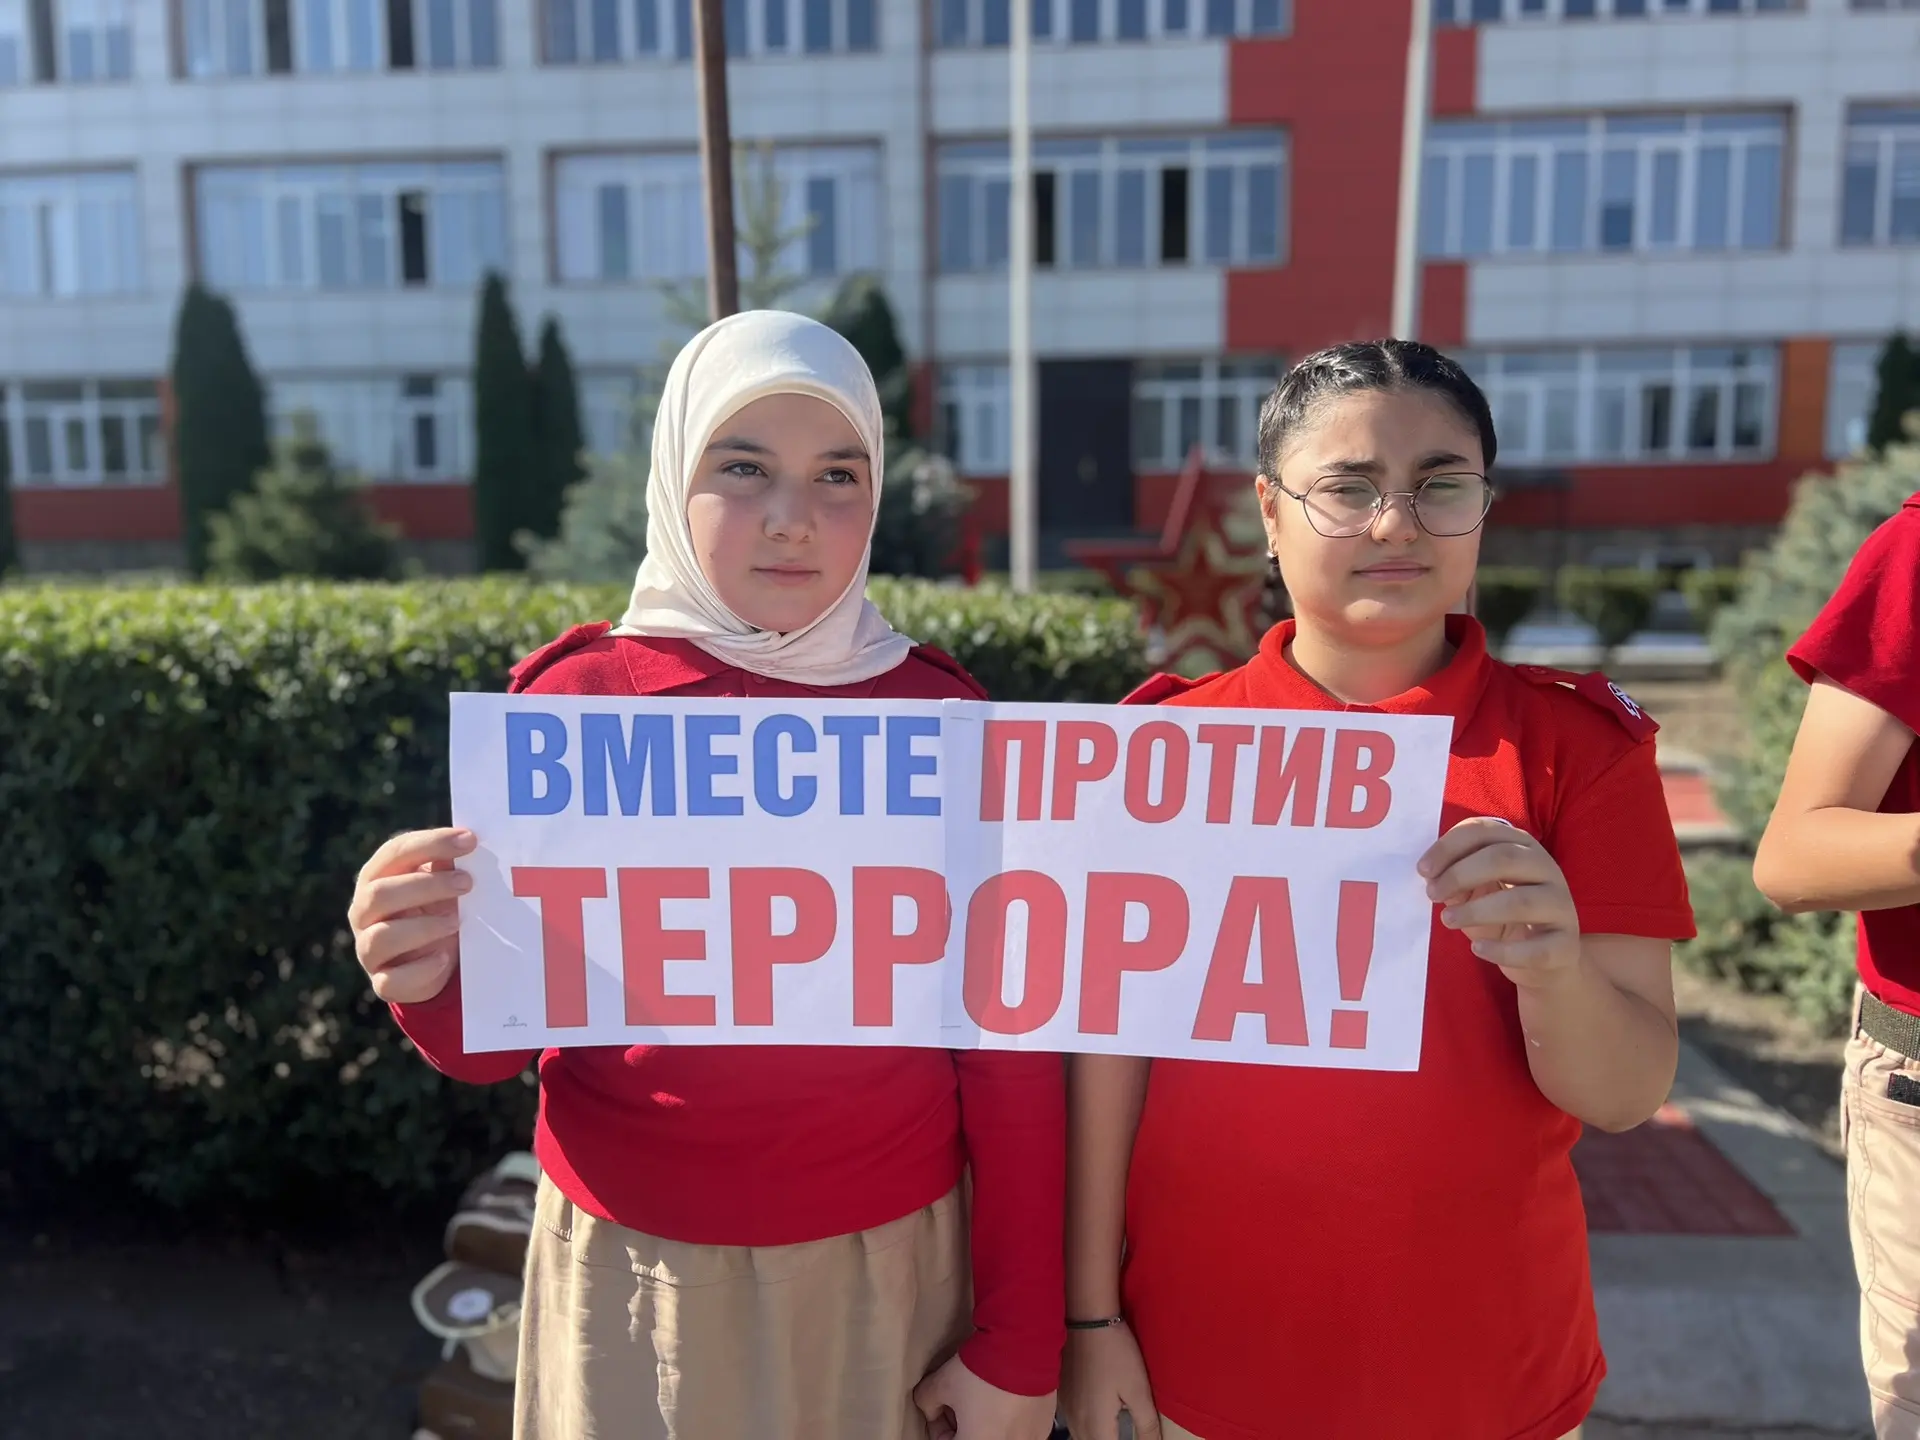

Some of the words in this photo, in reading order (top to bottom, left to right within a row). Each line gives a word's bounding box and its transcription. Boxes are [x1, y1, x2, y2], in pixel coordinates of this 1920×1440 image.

[505, 712, 941, 817] ВМЕСТЕ
[979, 719, 1395, 829] ПРОТИВ
[511, 866, 1378, 1049] ТЕРРОРА!
